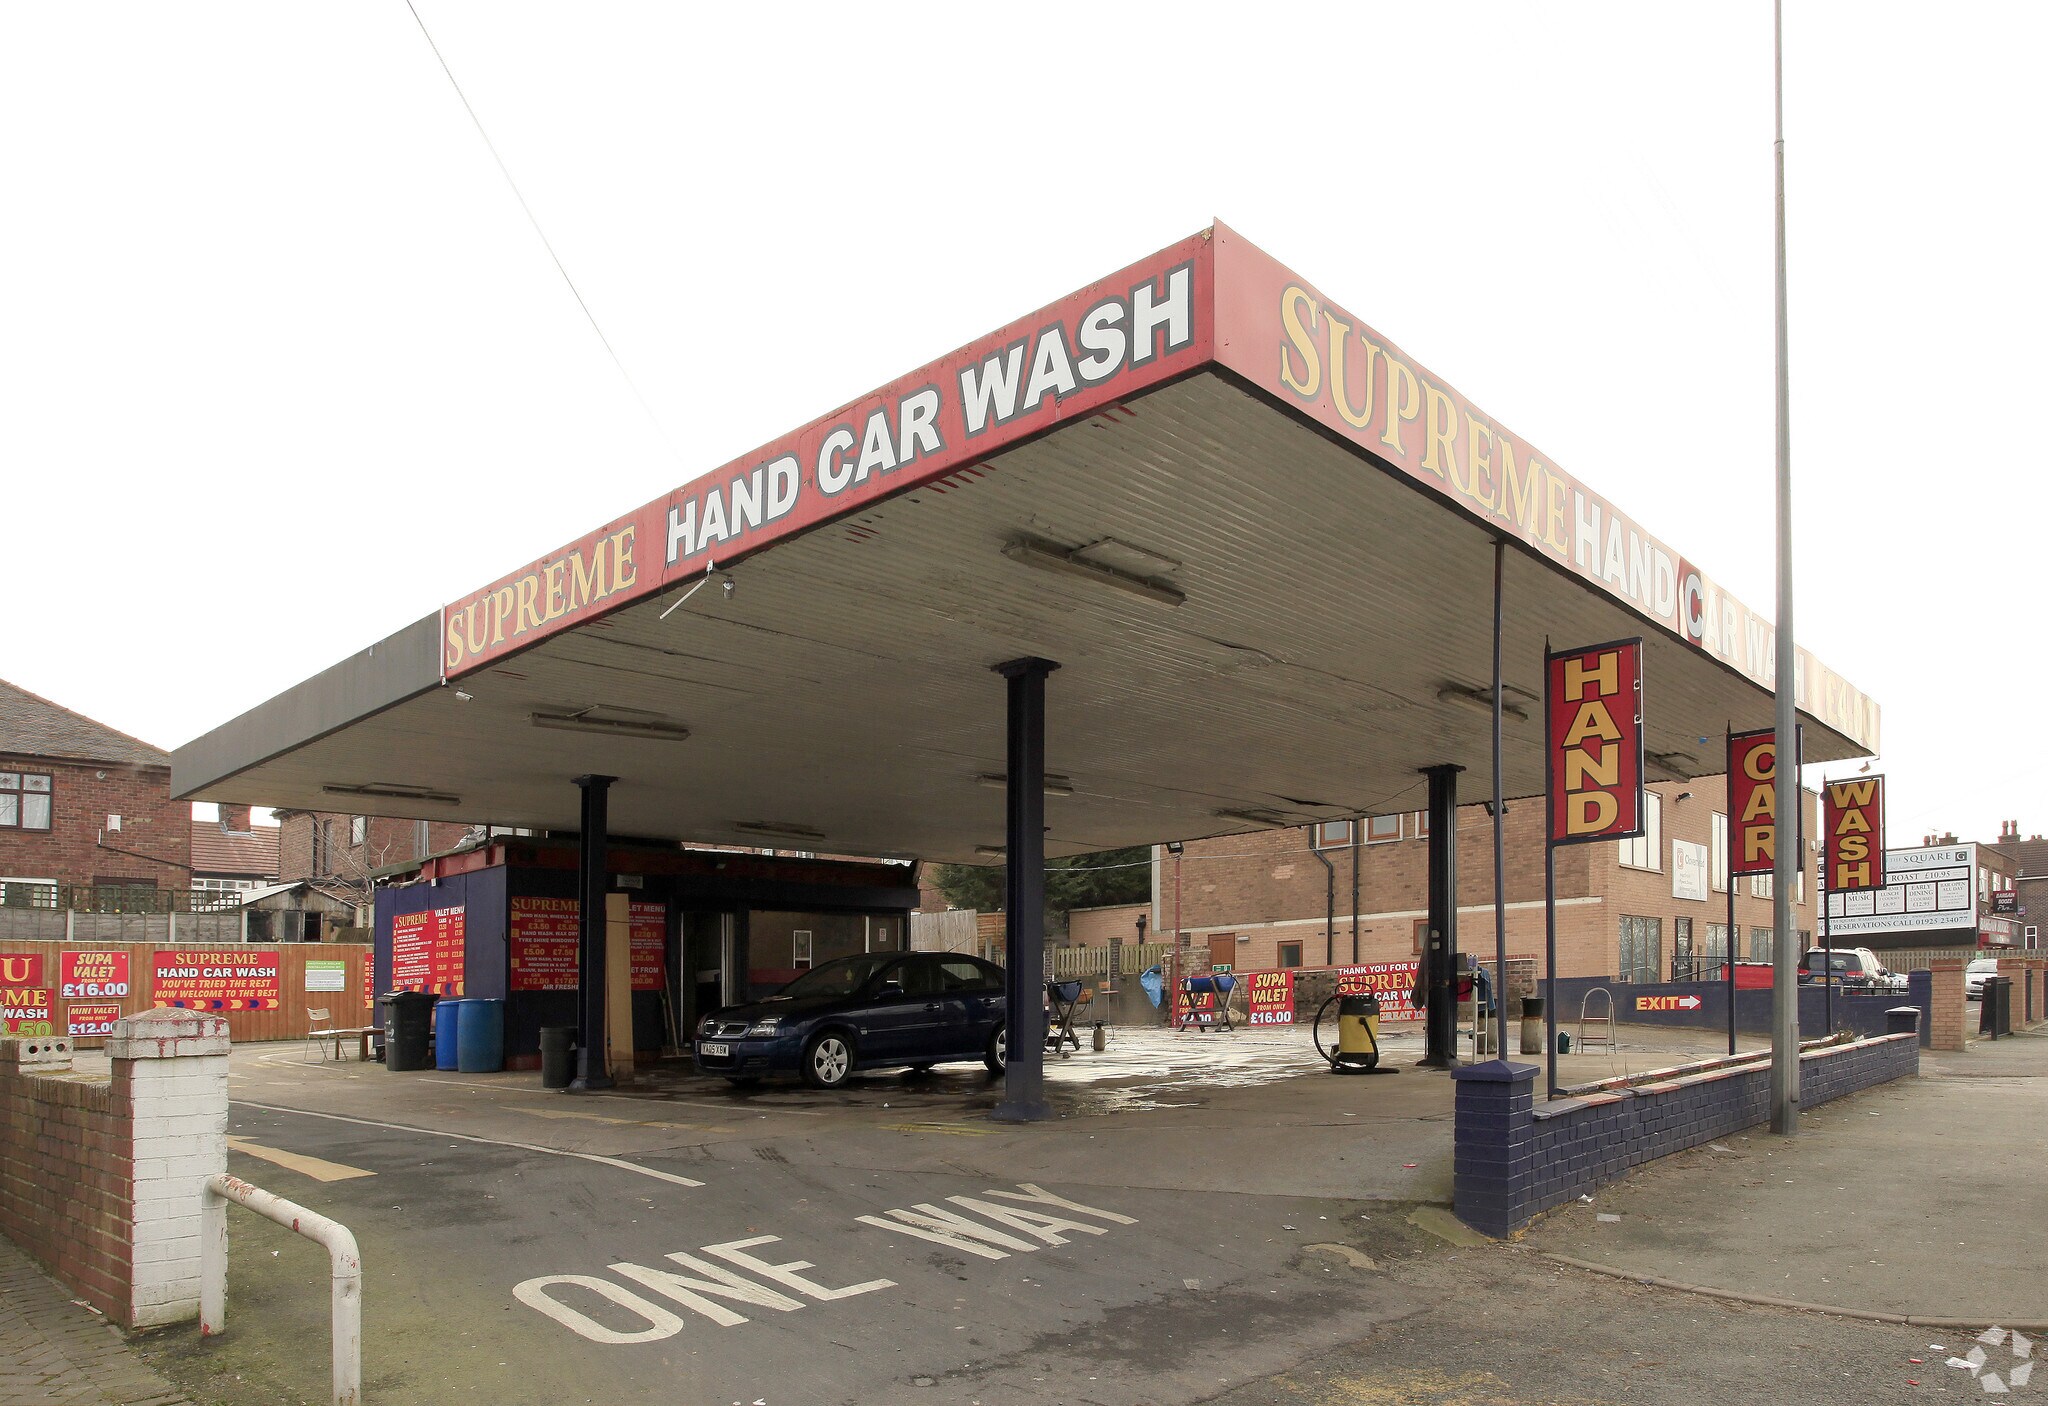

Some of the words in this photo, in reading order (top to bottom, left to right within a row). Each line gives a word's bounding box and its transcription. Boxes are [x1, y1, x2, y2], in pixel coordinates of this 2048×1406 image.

[446, 525, 637, 668] SUPREME
[667, 456, 799, 563] HAND
[816, 390, 942, 494] CAR
[960, 267, 1189, 434] WASH
[1281, 285, 1568, 556] SUPREME
[1574, 490, 1675, 618] HAND
[1685, 573, 1739, 662] CAR
[1743, 612, 1805, 703] WAH
[1562, 651, 1623, 836] HAND
[1741, 743, 1776, 862] CAR
[1829, 779, 1877, 889] WASH
[1903, 852, 1951, 863] SQUARE
[1891, 873, 1919, 882] ROAST
[1925, 871, 1951, 879] £10.95
[512, 898, 579, 911] SUPREME
[434, 908, 450, 917] VALET
[450, 906, 465, 915] MENU
[398, 913, 428, 927] SUPREME
[1833, 921, 1892, 930] RESERVATIONS
[76, 953, 113, 965] SUPA
[175, 953, 259, 965] SUPREME
[73, 966, 116, 978] VALET
[157, 968, 199, 978] HAND
[202, 968, 232, 978] CAR
[234, 967, 276, 978] WASH
[1338, 966, 1367, 976] THANK
[1369, 964, 1388, 972] YOU
[1390, 963, 1408, 972] FOR
[162, 980, 196, 988] YOU'VE
[198, 980, 226, 988] TRIED
[229, 980, 246, 988] THE
[249, 980, 272, 988] REST
[1255, 972, 1286, 988] SUPA
[1338, 972, 1416, 993] SUPREM
[63, 982, 128, 996] £16.00
[155, 990, 176, 998] NOW
[180, 990, 224, 998] WELCOME
[226, 990, 236, 998] TO
[239, 990, 256, 998] THE
[257, 989, 278, 998] BEST
[1374, 990, 1398, 1000] CAR
[0, 989, 48, 1006] ME
[1252, 988, 1288, 1004] VALET
[1636, 996, 1678, 1010] EXIT
[3, 1008, 48, 1019] WASH
[70, 1007, 91, 1015] MINI
[1250, 1011, 1292, 1024] £16.00
[1380, 1010, 1414, 1020] GREAT
[512, 1234, 899, 1344] ONE
[854, 1183, 1140, 1260] WAY
